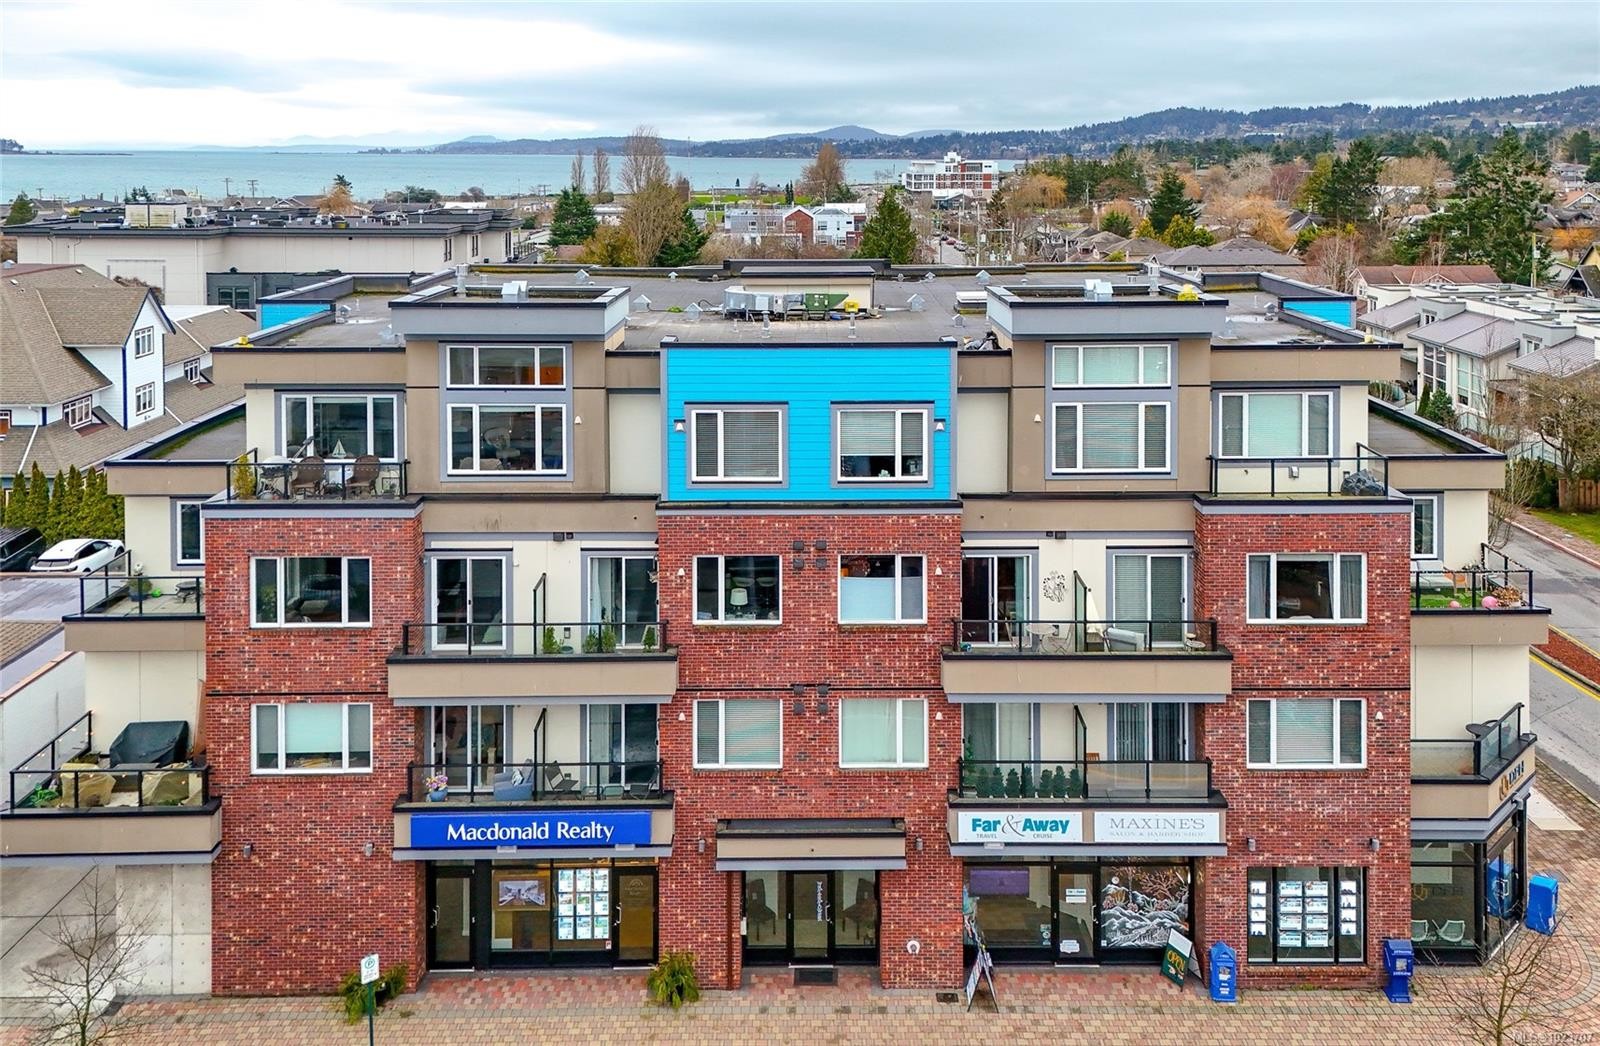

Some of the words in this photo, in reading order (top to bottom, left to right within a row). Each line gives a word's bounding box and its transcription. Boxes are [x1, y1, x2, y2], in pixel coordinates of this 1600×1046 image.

[447, 822, 549, 841] Macdonald
[557, 821, 614, 842] Realty
[971, 818, 1001, 832] Far
[1001, 814, 1025, 837] &
[1022, 818, 1070, 834] Away
[1110, 818, 1205, 830] MAXINE'S
[1168, 950, 1185, 971] OPEN
